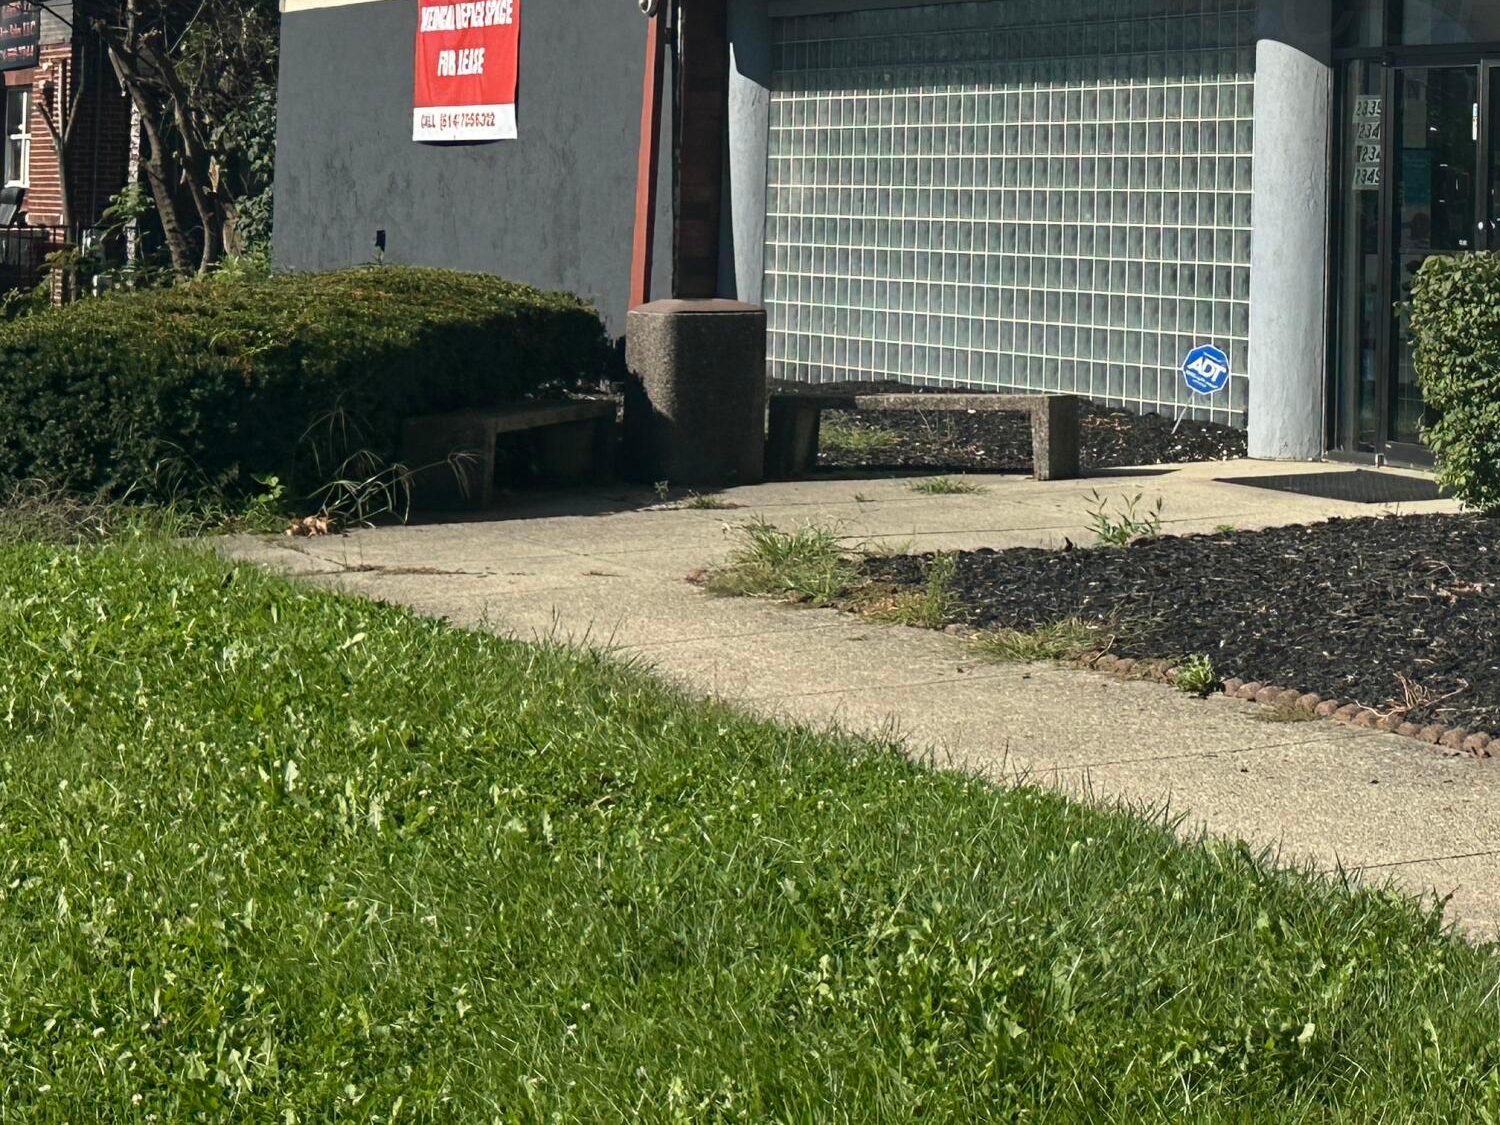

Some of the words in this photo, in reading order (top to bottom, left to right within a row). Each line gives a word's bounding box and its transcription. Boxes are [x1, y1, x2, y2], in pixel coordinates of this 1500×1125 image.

[437, 49, 456, 77] FOR
[457, 47, 485, 75] LEASE
[421, 114, 435, 129] CALL
[1187, 356, 1227, 382] ADT
